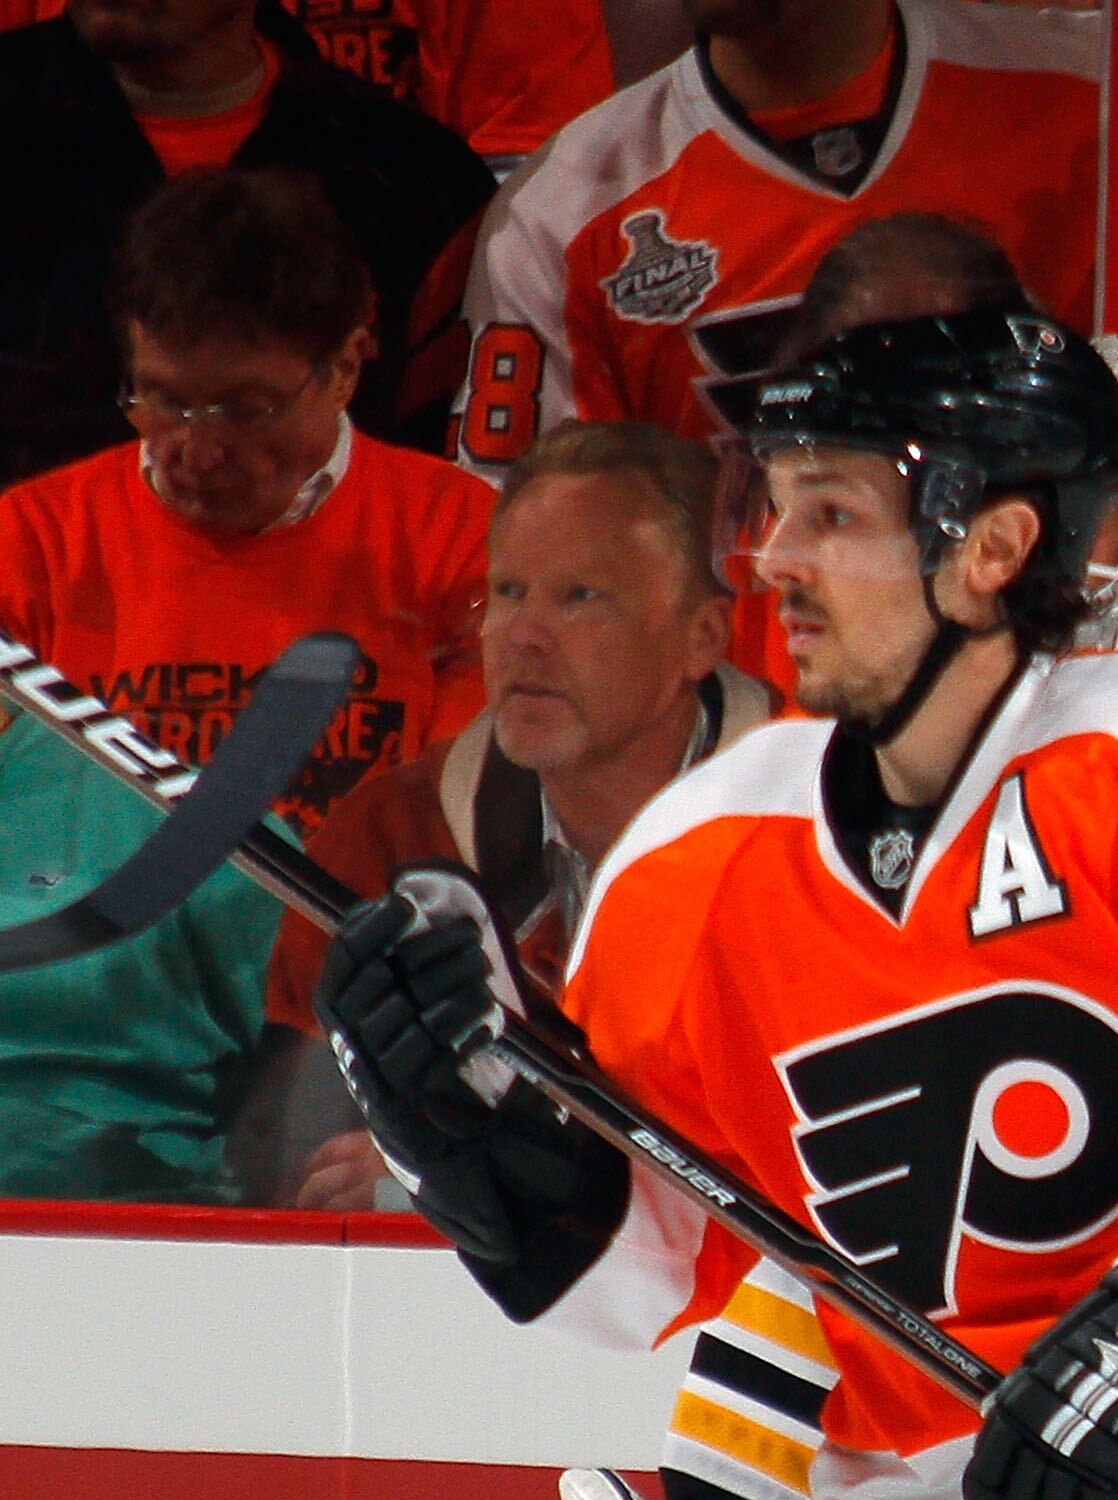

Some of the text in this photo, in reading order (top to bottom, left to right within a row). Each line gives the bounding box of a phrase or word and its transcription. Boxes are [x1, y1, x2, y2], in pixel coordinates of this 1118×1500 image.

[613, 249, 711, 299] FINAL
[443, 321, 546, 466] 8
[968, 769, 1072, 944] A
[628, 1127, 737, 1208] BAUER
